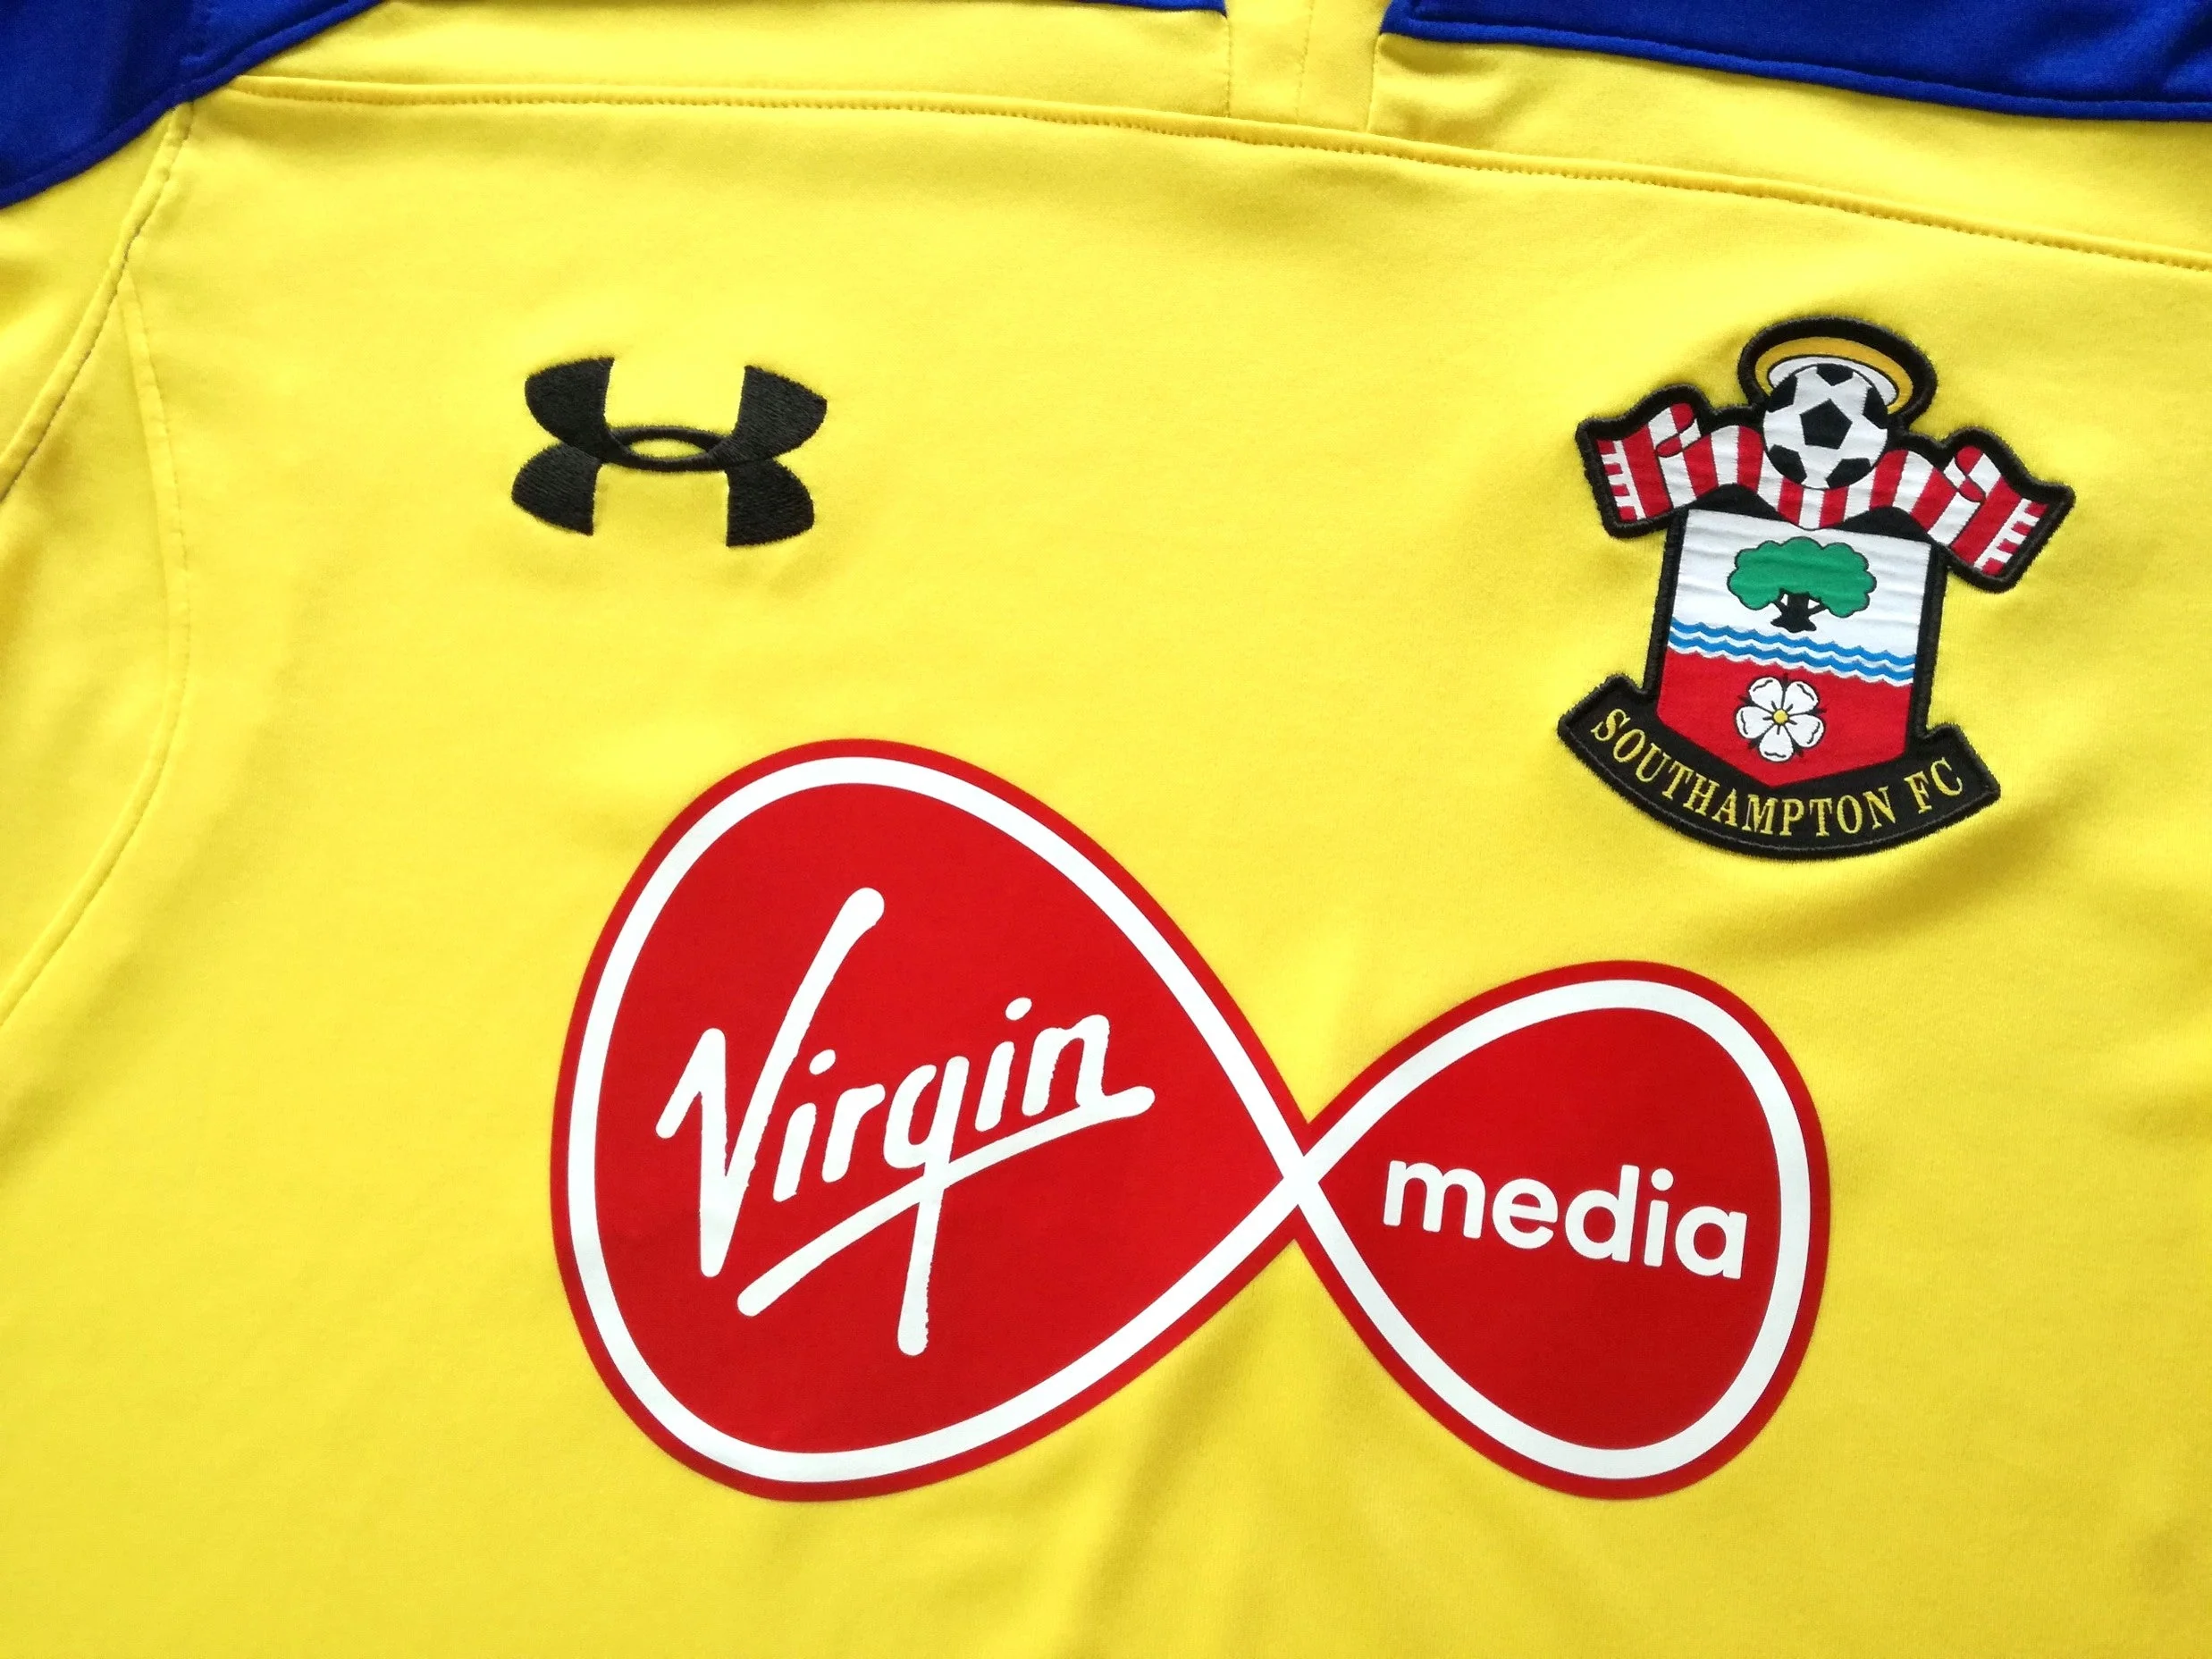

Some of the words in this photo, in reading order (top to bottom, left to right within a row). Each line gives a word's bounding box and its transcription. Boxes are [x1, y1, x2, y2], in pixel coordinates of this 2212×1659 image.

[1590, 708, 1897, 838] SOUTHAMPTON
[1905, 758, 1964, 813] FC
[655, 887, 1156, 1357] Virgin
[1383, 1159, 1748, 1280] media
